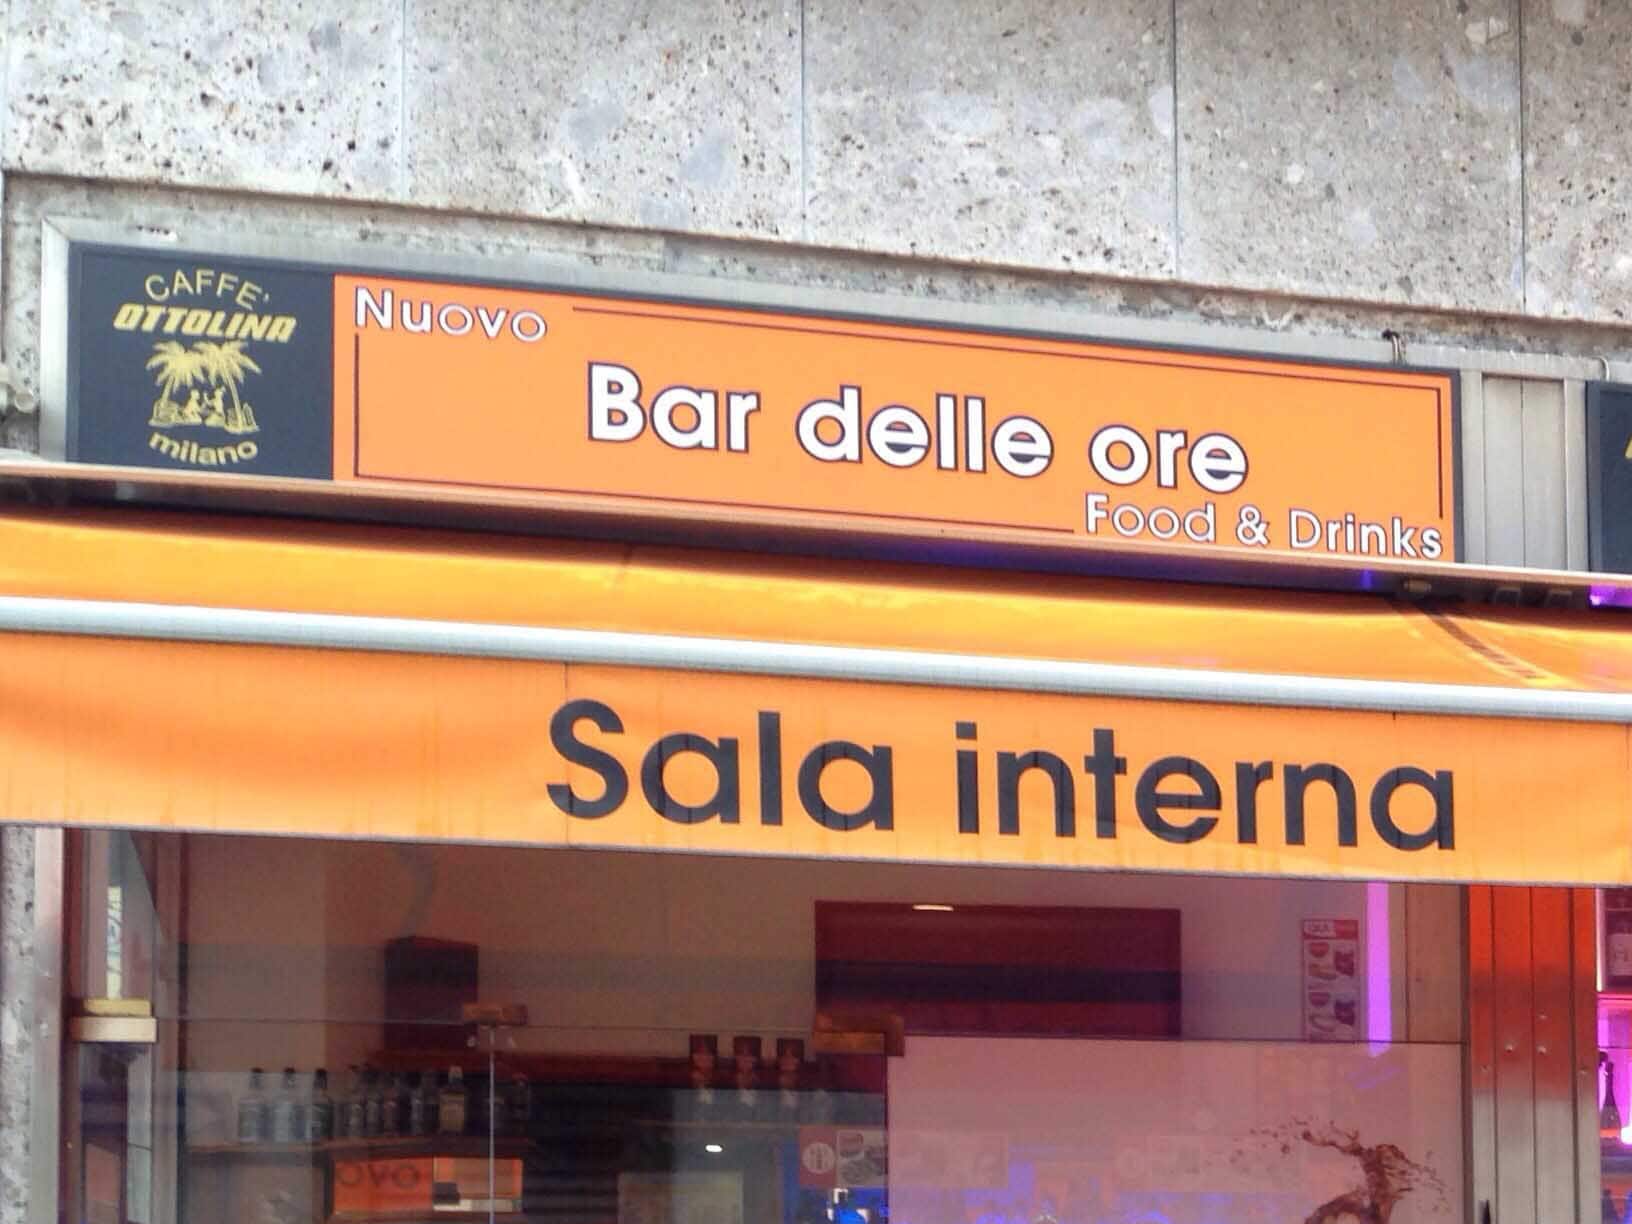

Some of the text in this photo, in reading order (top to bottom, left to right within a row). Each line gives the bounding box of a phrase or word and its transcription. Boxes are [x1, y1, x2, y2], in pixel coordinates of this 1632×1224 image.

[113, 302, 297, 344] OTTOLINA
[353, 286, 548, 344] Nuovo
[148, 431, 259, 466] milano
[587, 361, 1249, 494] Bar delle ore
[1085, 493, 1442, 560] Food & Drinks
[545, 697, 1455, 851] Sala interna
